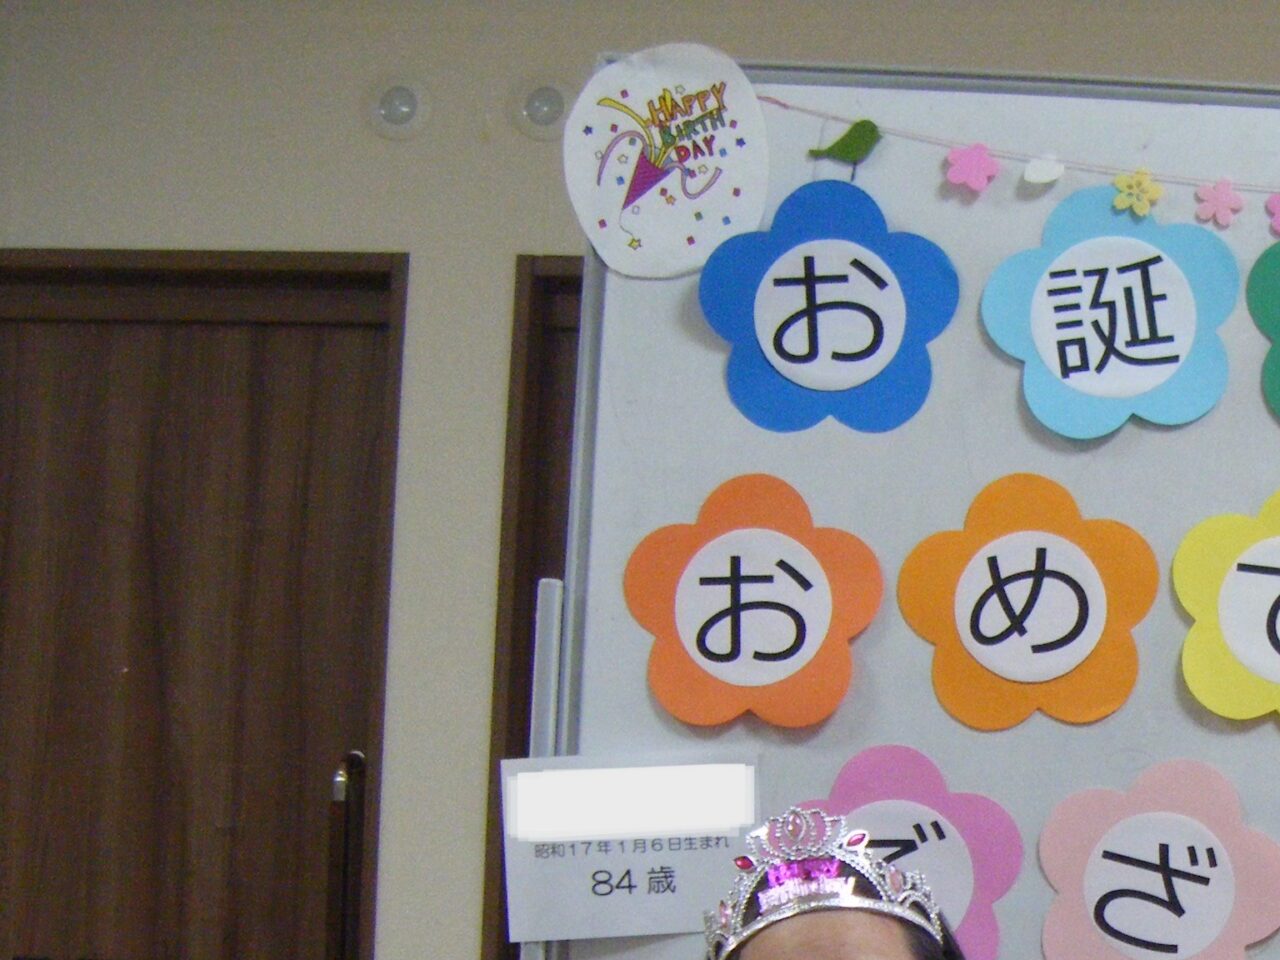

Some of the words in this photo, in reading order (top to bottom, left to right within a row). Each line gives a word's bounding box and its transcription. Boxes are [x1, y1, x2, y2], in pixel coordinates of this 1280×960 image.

[647, 81, 727, 129] HAPPY
[659, 110, 726, 148] BIRTH
[674, 134, 716, 163] DAY
[591, 865, 677, 897] 84歳
